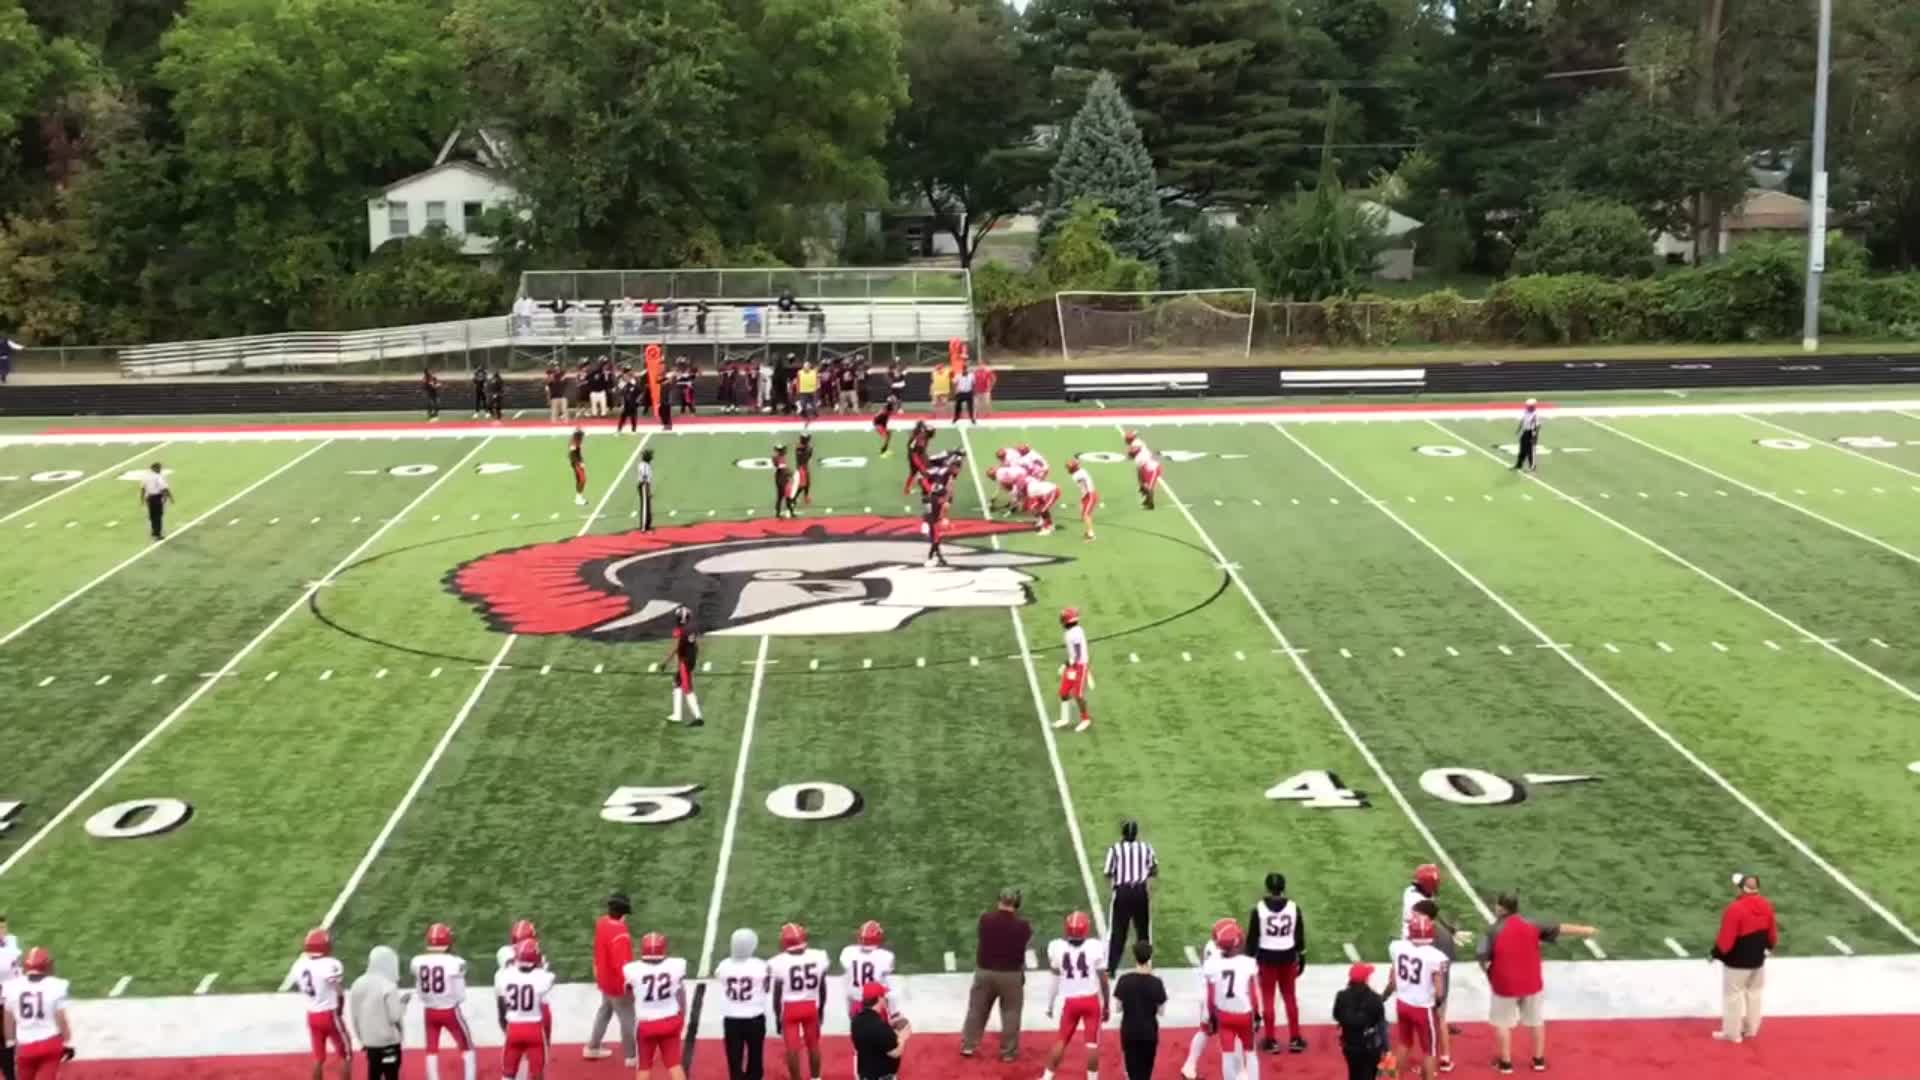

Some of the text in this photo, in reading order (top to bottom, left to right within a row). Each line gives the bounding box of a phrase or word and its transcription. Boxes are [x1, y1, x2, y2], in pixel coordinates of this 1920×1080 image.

[1266, 914, 1293, 937] 52
[419, 965, 446, 994] 88
[789, 963, 819, 992] 65
[852, 961, 875, 987] 18
[1061, 952, 1089, 980] 44
[1397, 953, 1423, 985] 63
[505, 984, 535, 1012] 30
[641, 972, 672, 1002] 72
[1221, 970, 1237, 999] 7
[18, 990, 45, 1020] 61
